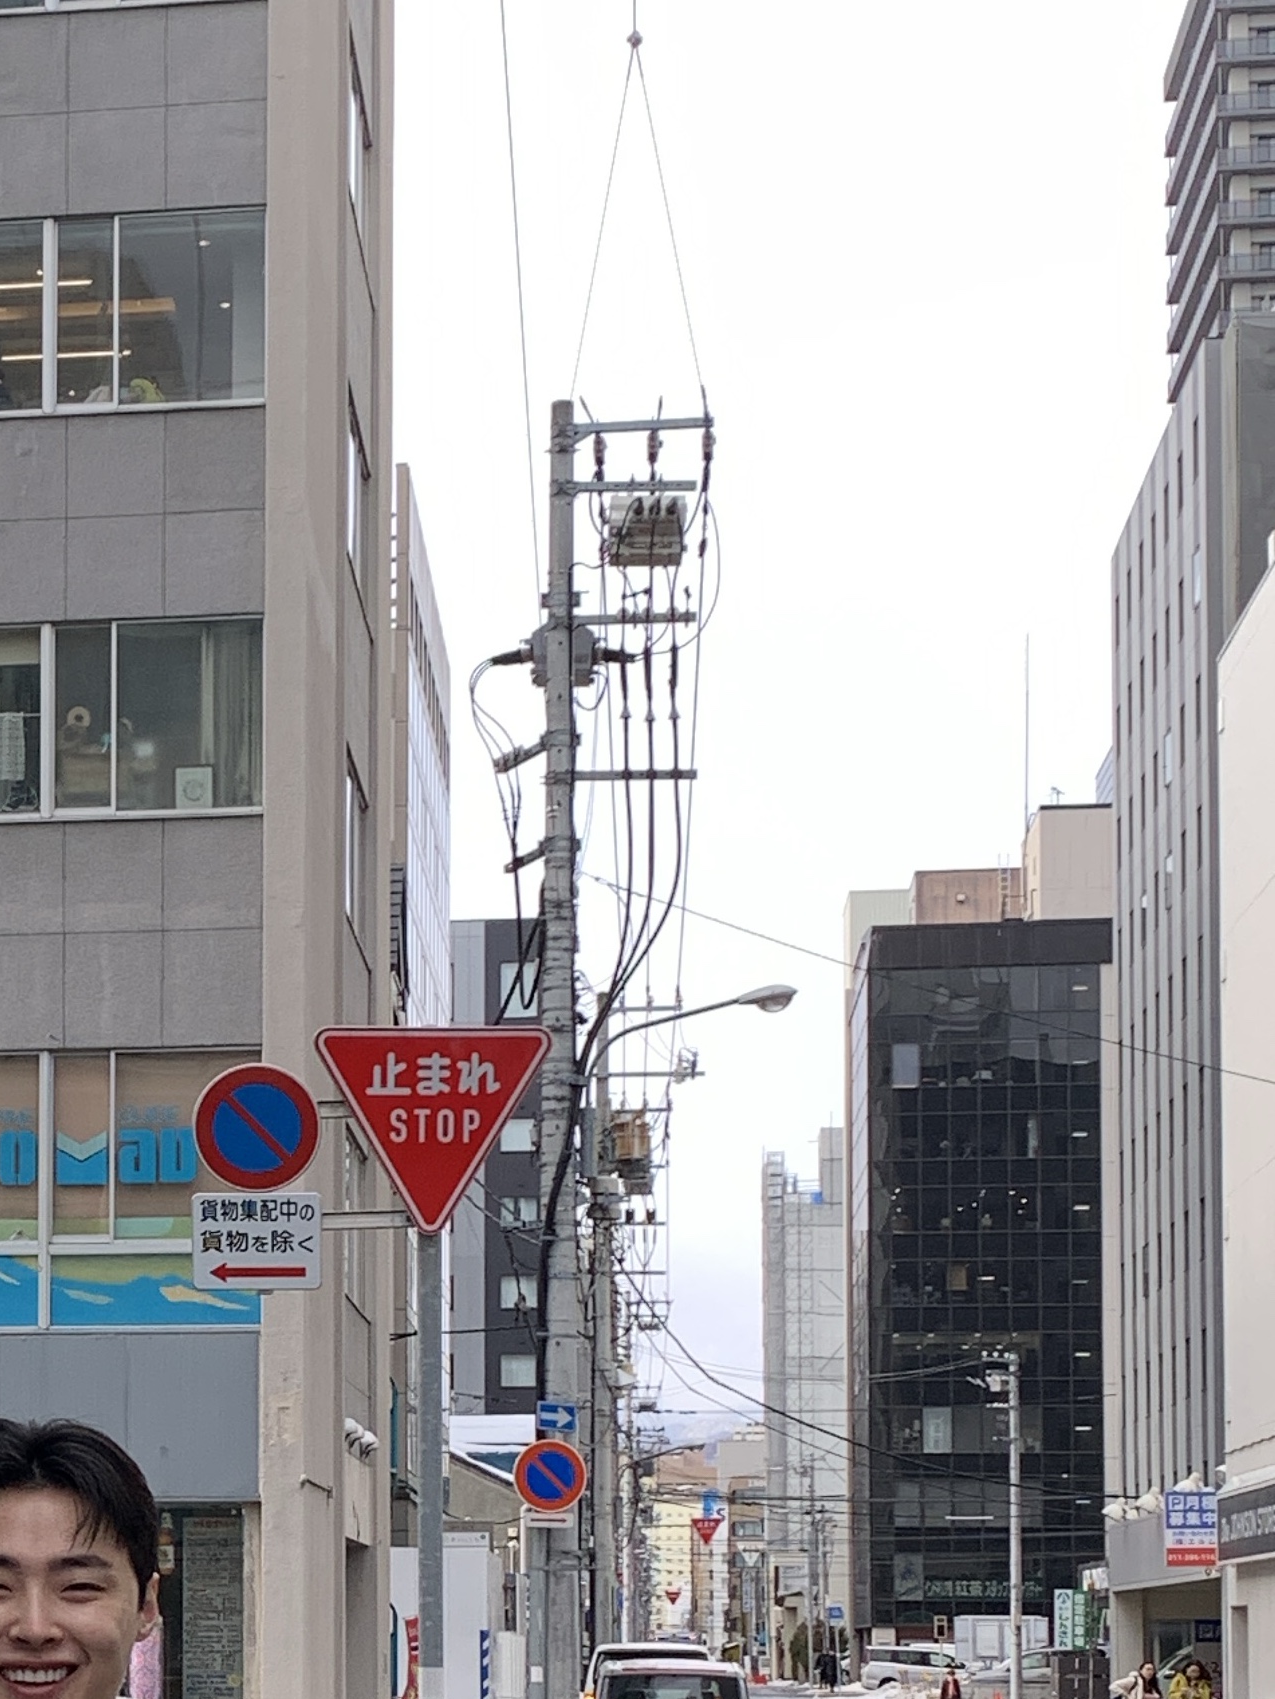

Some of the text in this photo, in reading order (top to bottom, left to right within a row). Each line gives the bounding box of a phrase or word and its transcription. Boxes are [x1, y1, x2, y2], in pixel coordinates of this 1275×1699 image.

[365, 1051, 502, 1096] 止まれ
[389, 1107, 481, 1144] STOP
[199, 1198, 315, 1222] 貨物集配中の
[199, 1229, 314, 1254] 貨物を除く
